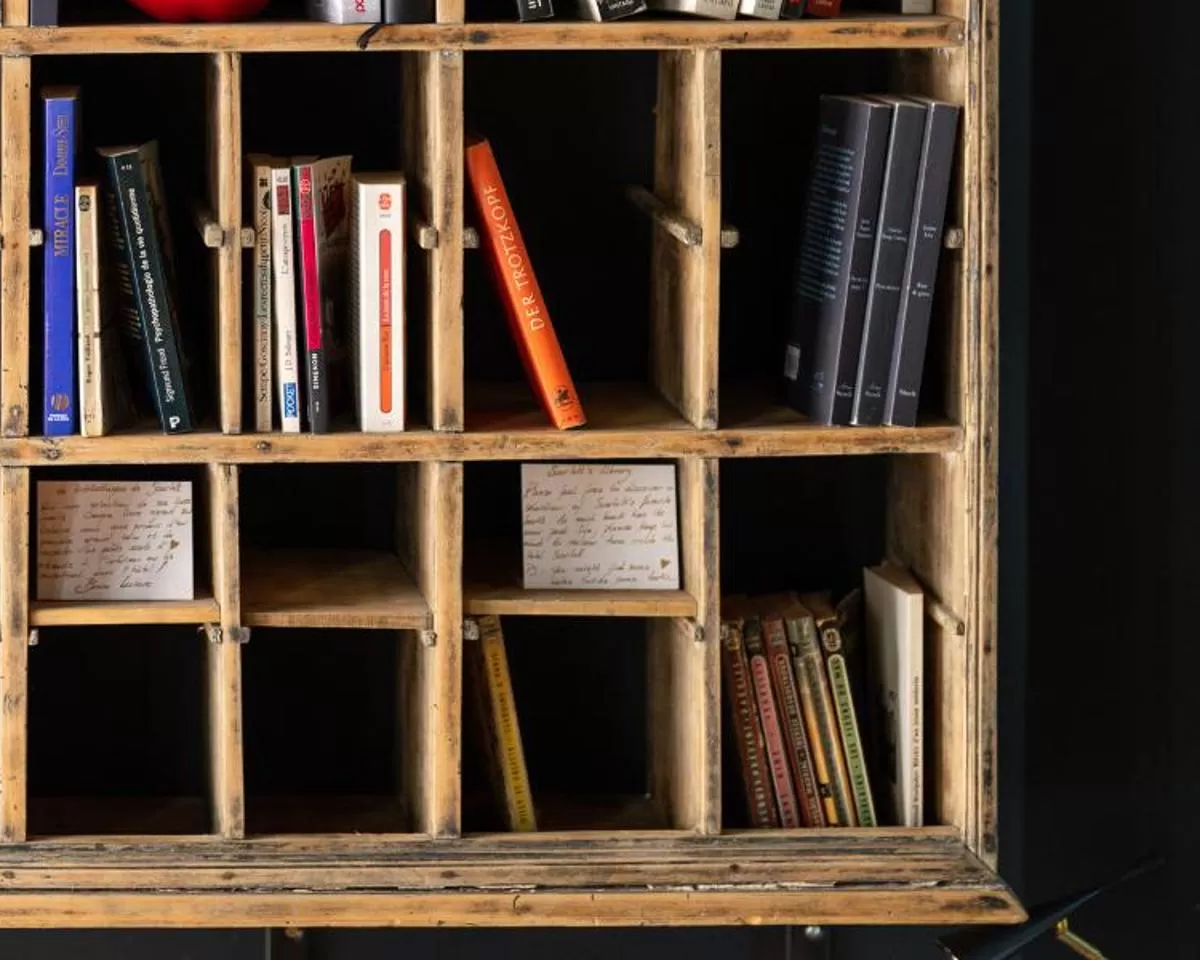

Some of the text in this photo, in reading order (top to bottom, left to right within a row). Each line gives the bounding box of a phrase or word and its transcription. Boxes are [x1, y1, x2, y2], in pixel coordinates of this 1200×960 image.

[53, 193, 70, 257] MIRACLE
[482, 183, 546, 331] DER TROTZKOPF
[136, 249, 151, 271] de la
